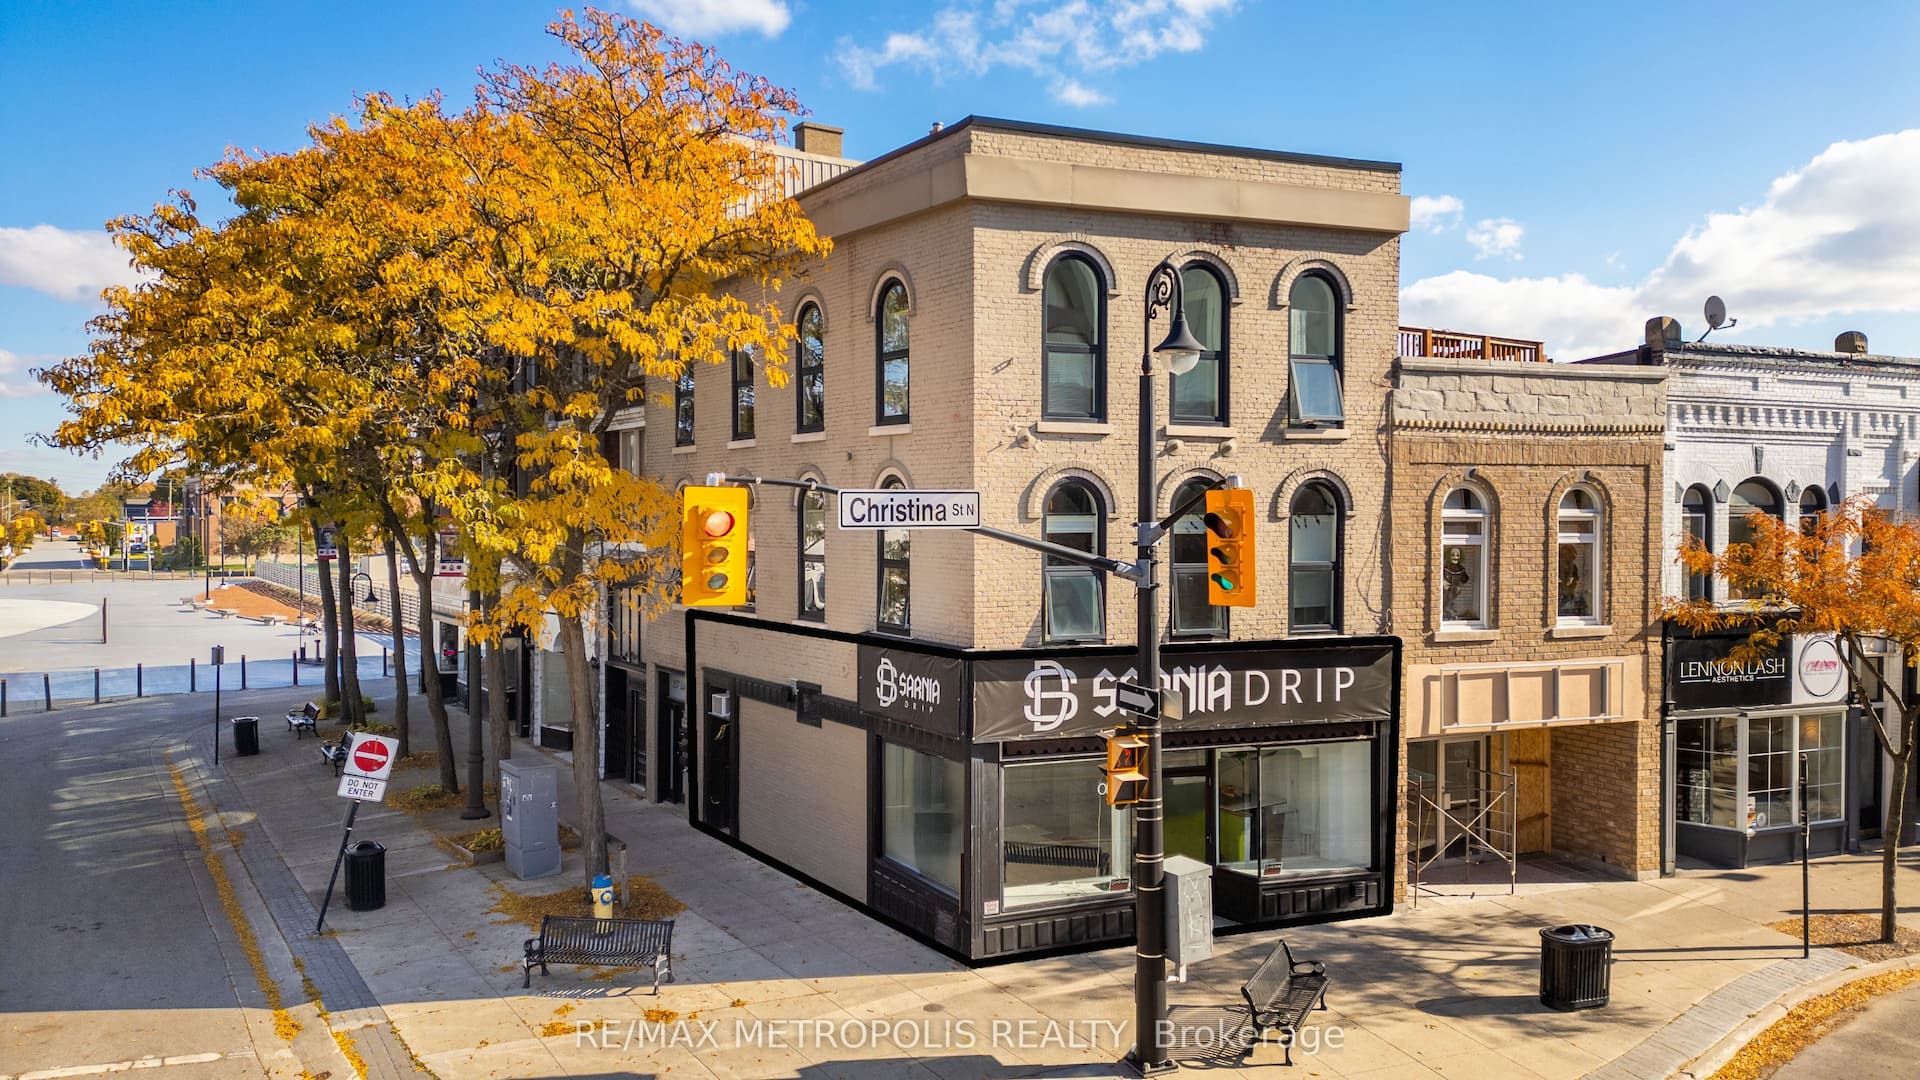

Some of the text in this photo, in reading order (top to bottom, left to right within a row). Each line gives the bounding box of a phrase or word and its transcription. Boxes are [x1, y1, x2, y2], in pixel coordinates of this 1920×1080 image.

[850, 497, 974, 523] Christina St N
[1680, 660, 1745, 678] LENNON
[1747, 657, 1785, 675] LASH
[1244, 666, 1355, 706] DRIP
[1711, 674, 1754, 683] AESTHETICS
[899, 672, 940, 704] SARNIA
[904, 700, 934, 714] DRIP
[347, 787, 374, 797] ENTER
[362, 781, 378, 790] NOT
